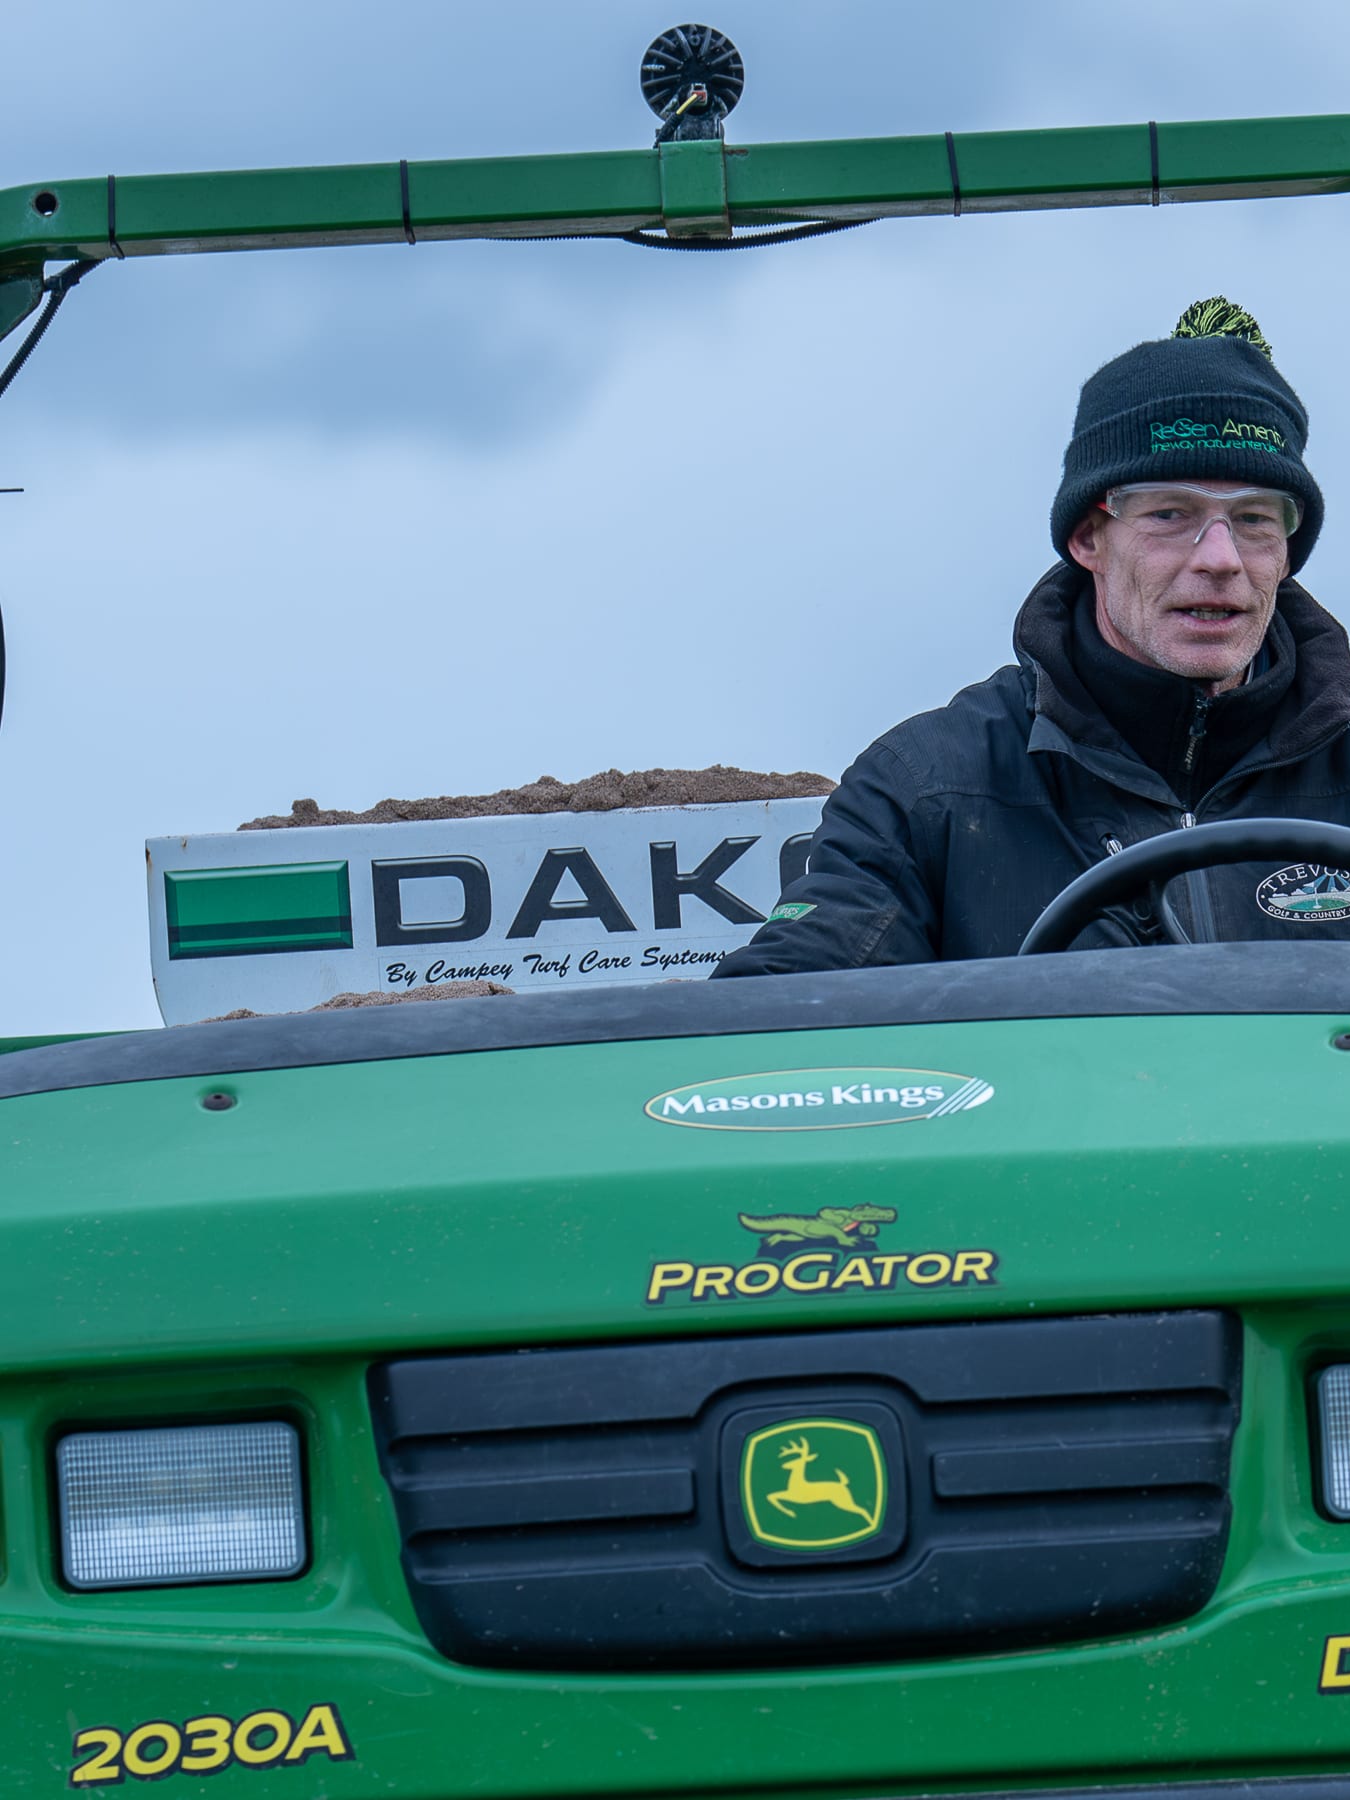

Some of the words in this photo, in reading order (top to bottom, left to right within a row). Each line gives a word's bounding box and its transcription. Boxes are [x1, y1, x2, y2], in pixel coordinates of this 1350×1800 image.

[1150, 417, 1220, 441] ReGen
[370, 832, 816, 947] DAK
[1267, 904, 1290, 919] GOLF
[1293, 912, 1301, 920] &
[1303, 908, 1347, 920] COUNTRY
[385, 962, 418, 987] By
[425, 959, 514, 983] Campey
[522, 953, 571, 978] Turf
[578, 949, 633, 974] Care
[640, 946, 727, 971] Systems
[661, 1088, 826, 1116] Masons
[831, 1083, 946, 1108] Kings
[71, 1704, 348, 1783] 2030A
